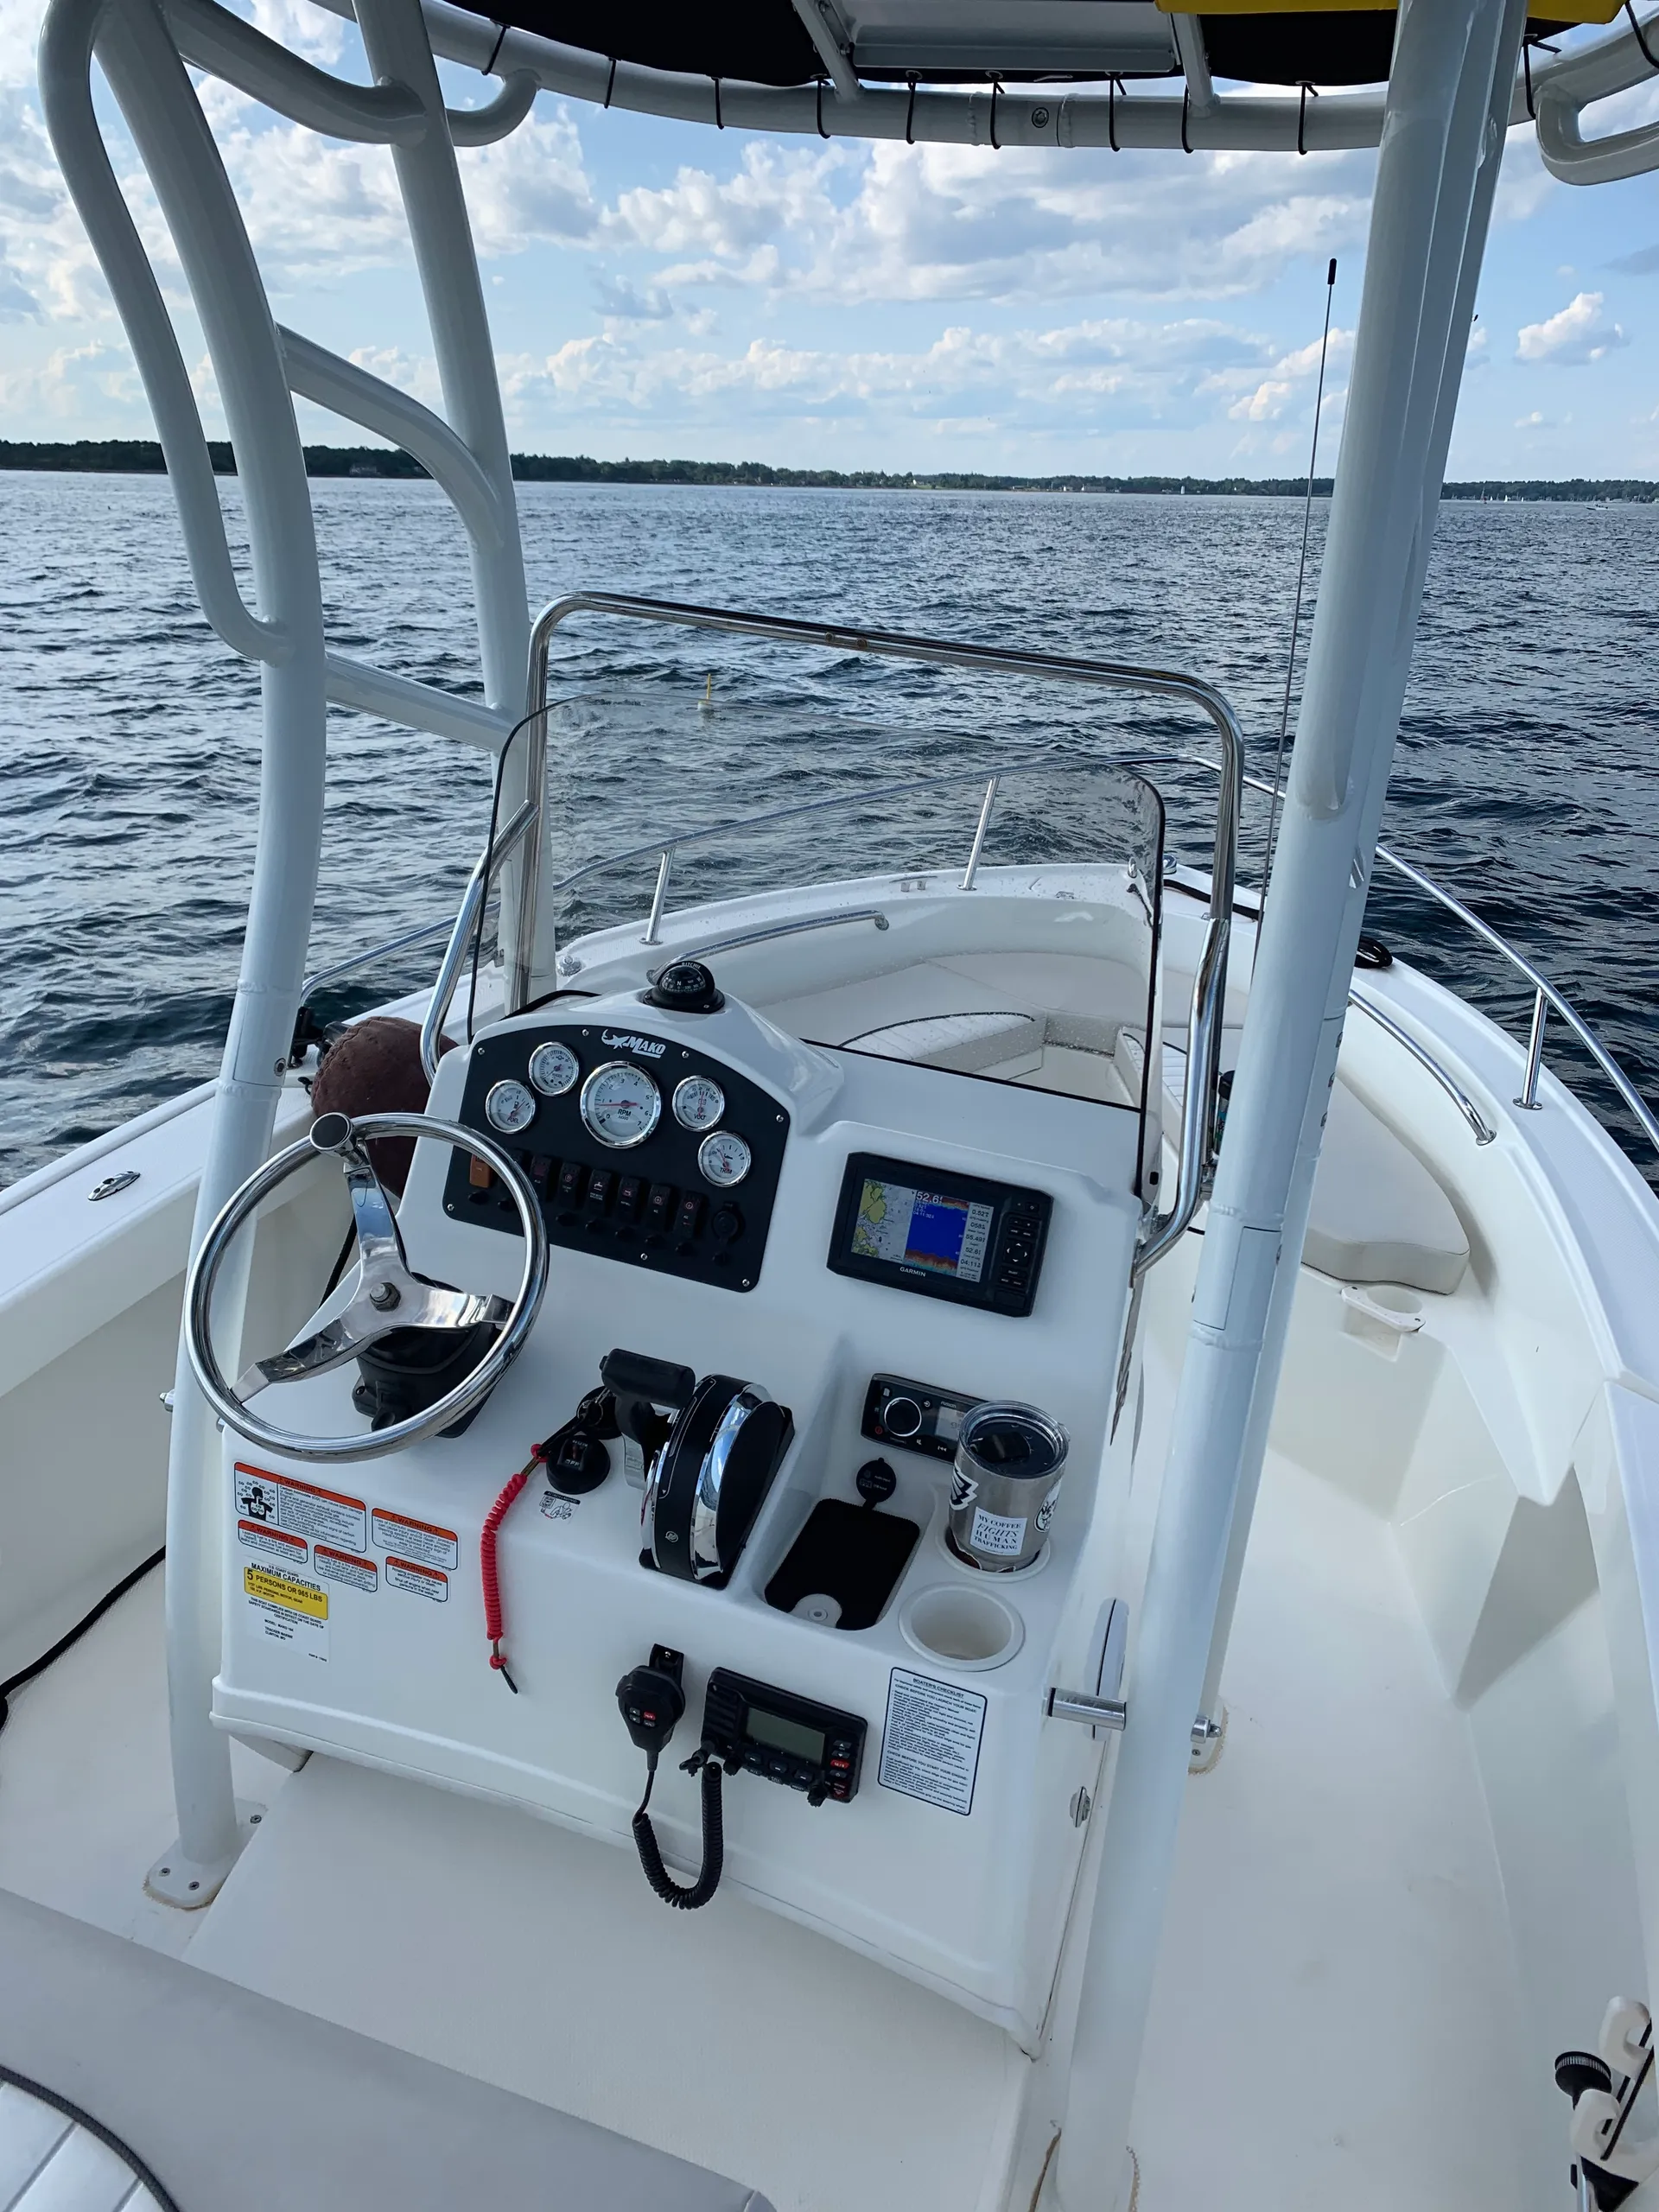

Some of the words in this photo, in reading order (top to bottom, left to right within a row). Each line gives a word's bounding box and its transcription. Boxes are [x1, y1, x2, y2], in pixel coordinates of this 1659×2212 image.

[624, 1036, 666, 1058] MAKO
[507, 1116, 519, 1124] FUEL
[617, 1109, 632, 1117] RPM
[899, 1266, 926, 1277] GARMIN
[284, 1479, 316, 1493] WARNING
[398, 1517, 432, 1532] WARNING
[977, 1523, 1017, 1537] FIGHTS
[991, 1520, 1021, 1529] COFFEE
[257, 1527, 288, 1541] WARNING
[976, 1530, 1016, 1543] HUMAN
[975, 1536, 1017, 1550] TRAFFICKING
[329, 1551, 361, 1565] WARNING
[401, 1562, 432, 1576] WARNING
[252, 1562, 281, 1578] MAXIMUM
[283, 1573, 320, 1592] CAPACITIES
[247, 1568, 253, 1581] 5
[256, 1574, 286, 1591] PERSONS
[287, 1585, 297, 1594] OR
[310, 1592, 322, 1603] LBS
[913, 1678, 936, 1690] BOATER'S
[937, 1685, 964, 1699] CHECKLIST
